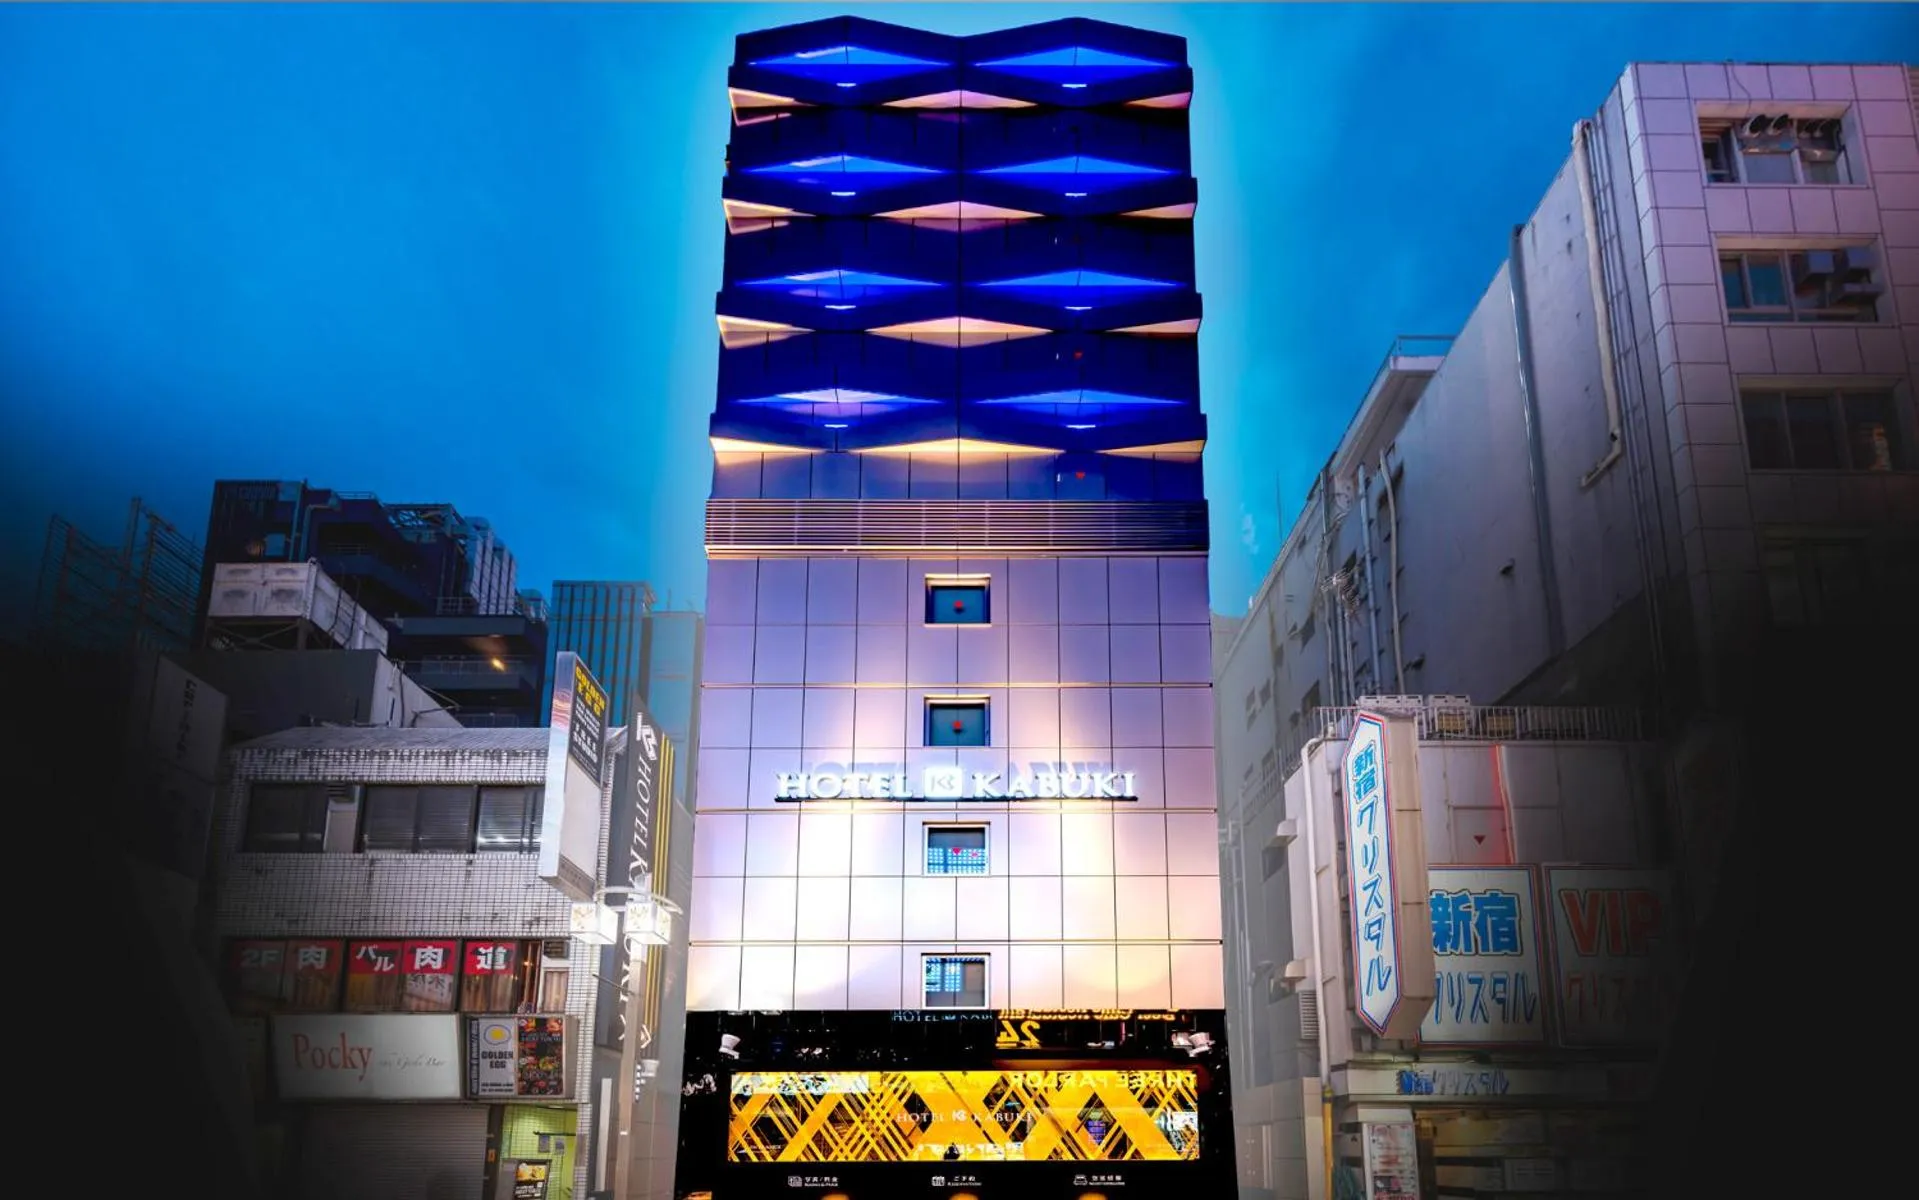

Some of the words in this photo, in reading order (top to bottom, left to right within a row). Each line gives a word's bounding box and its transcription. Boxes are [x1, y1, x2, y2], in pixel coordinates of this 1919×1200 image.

[776, 772, 912, 798] HOTEL
[972, 772, 1136, 798] KABUKI
[1353, 742, 1391, 996] 新宿クリスタル
[1430, 890, 1520, 955] 新宿
[1558, 889, 1662, 955] VIP
[292, 1032, 373, 1081] Pocky
[481, 1051, 514, 1060] GOLDEN
